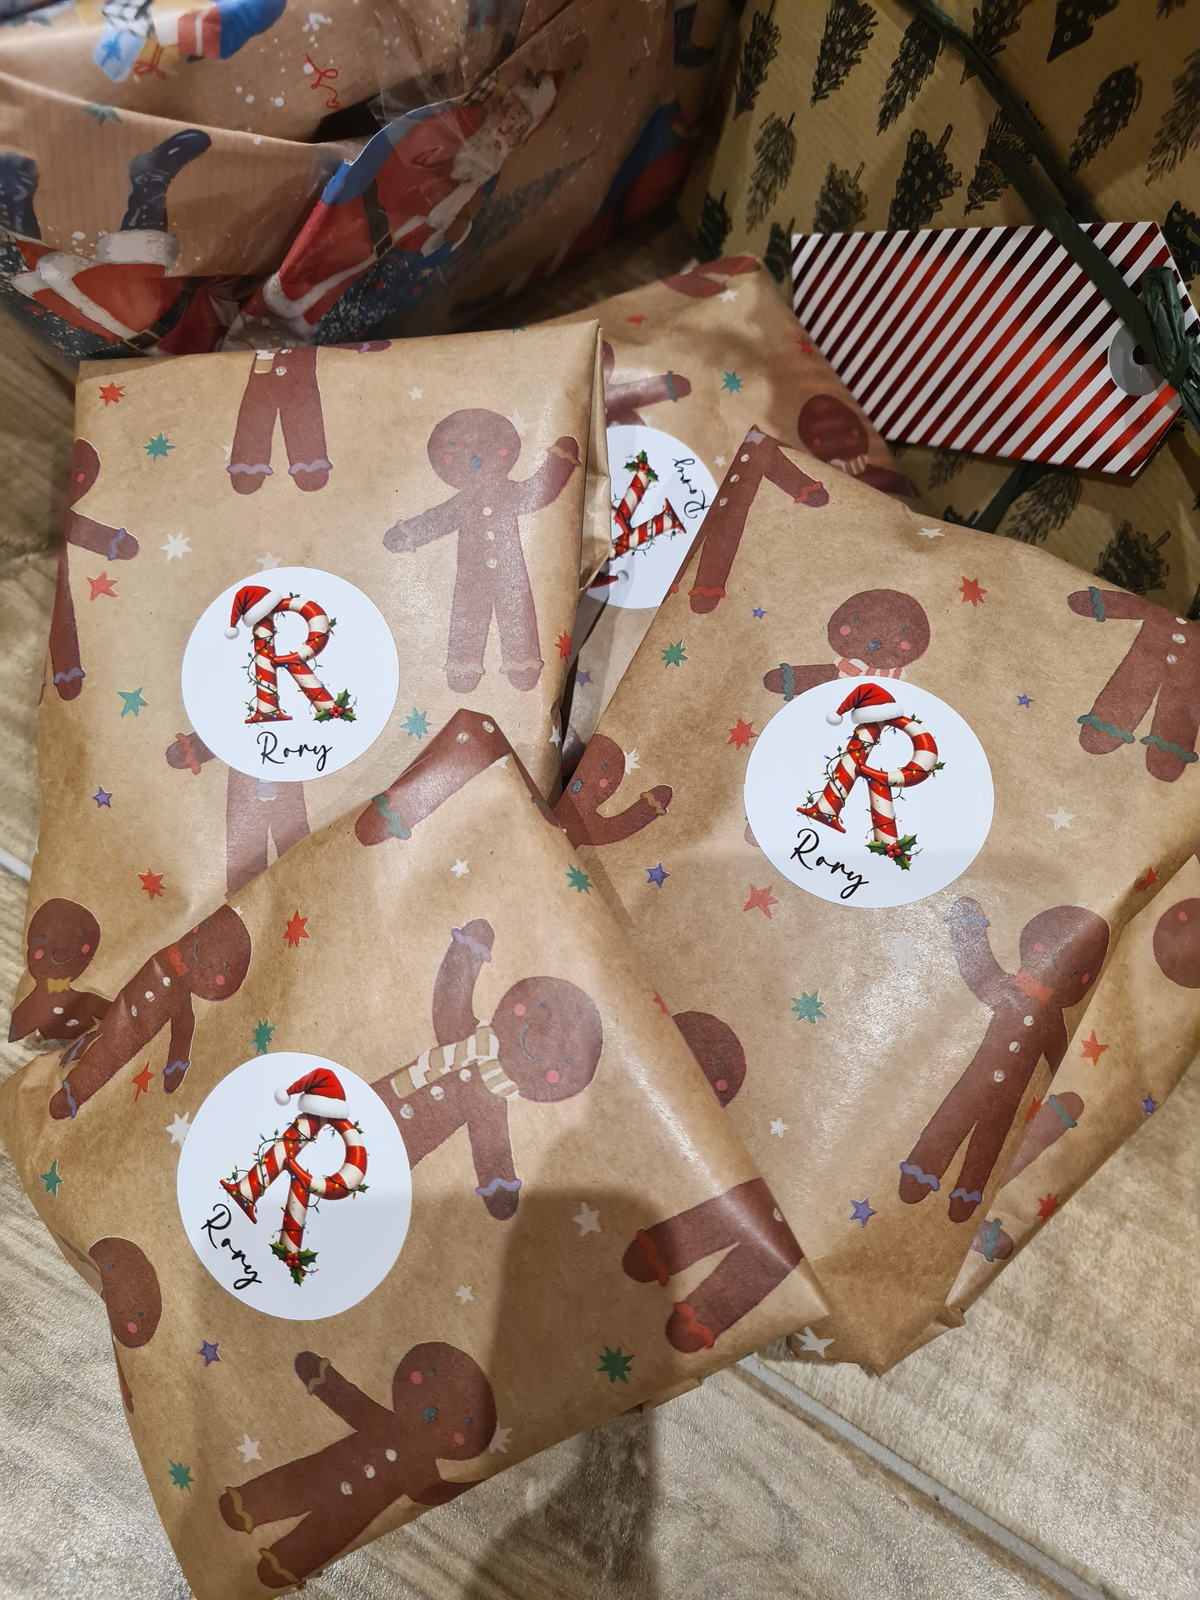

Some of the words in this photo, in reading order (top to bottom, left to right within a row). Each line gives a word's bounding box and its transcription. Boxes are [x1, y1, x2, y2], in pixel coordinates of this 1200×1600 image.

[672, 457, 711, 520] Rory
[244, 592, 358, 724] R
[256, 731, 334, 772] Rory
[795, 713, 944, 871] R
[789, 828, 870, 900] Rory
[219, 1110, 368, 1287] R
[200, 1203, 263, 1291] Rory
